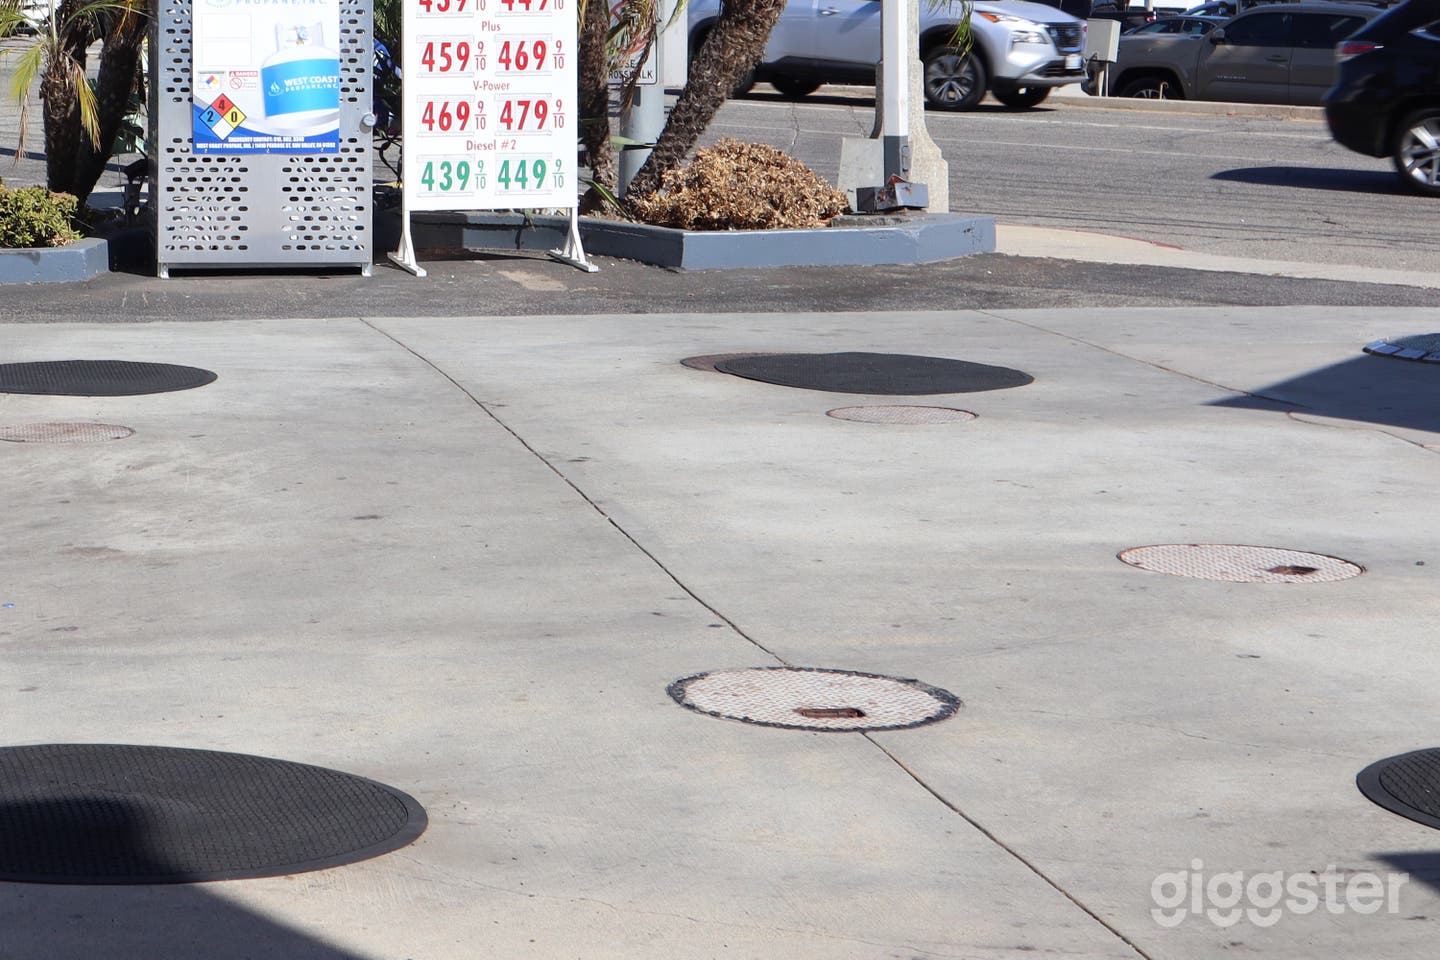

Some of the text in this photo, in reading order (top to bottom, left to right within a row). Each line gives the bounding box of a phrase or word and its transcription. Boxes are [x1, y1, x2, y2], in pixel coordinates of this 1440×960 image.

[481, 20, 501, 32] Plus
[421, 41, 471, 72] 459
[498, 40, 547, 71] 469
[284, 75, 338, 87] WEST COAST
[473, 80, 510, 91] V-Power
[218, 98, 225, 110] 4
[207, 111, 214, 123] 2
[231, 112, 238, 123] 0
[421, 101, 471, 131] 469
[499, 100, 549, 131] 479
[466, 139, 517, 151] Diesel #2
[421, 161, 471, 191] 439
[497, 159, 547, 190] 449
